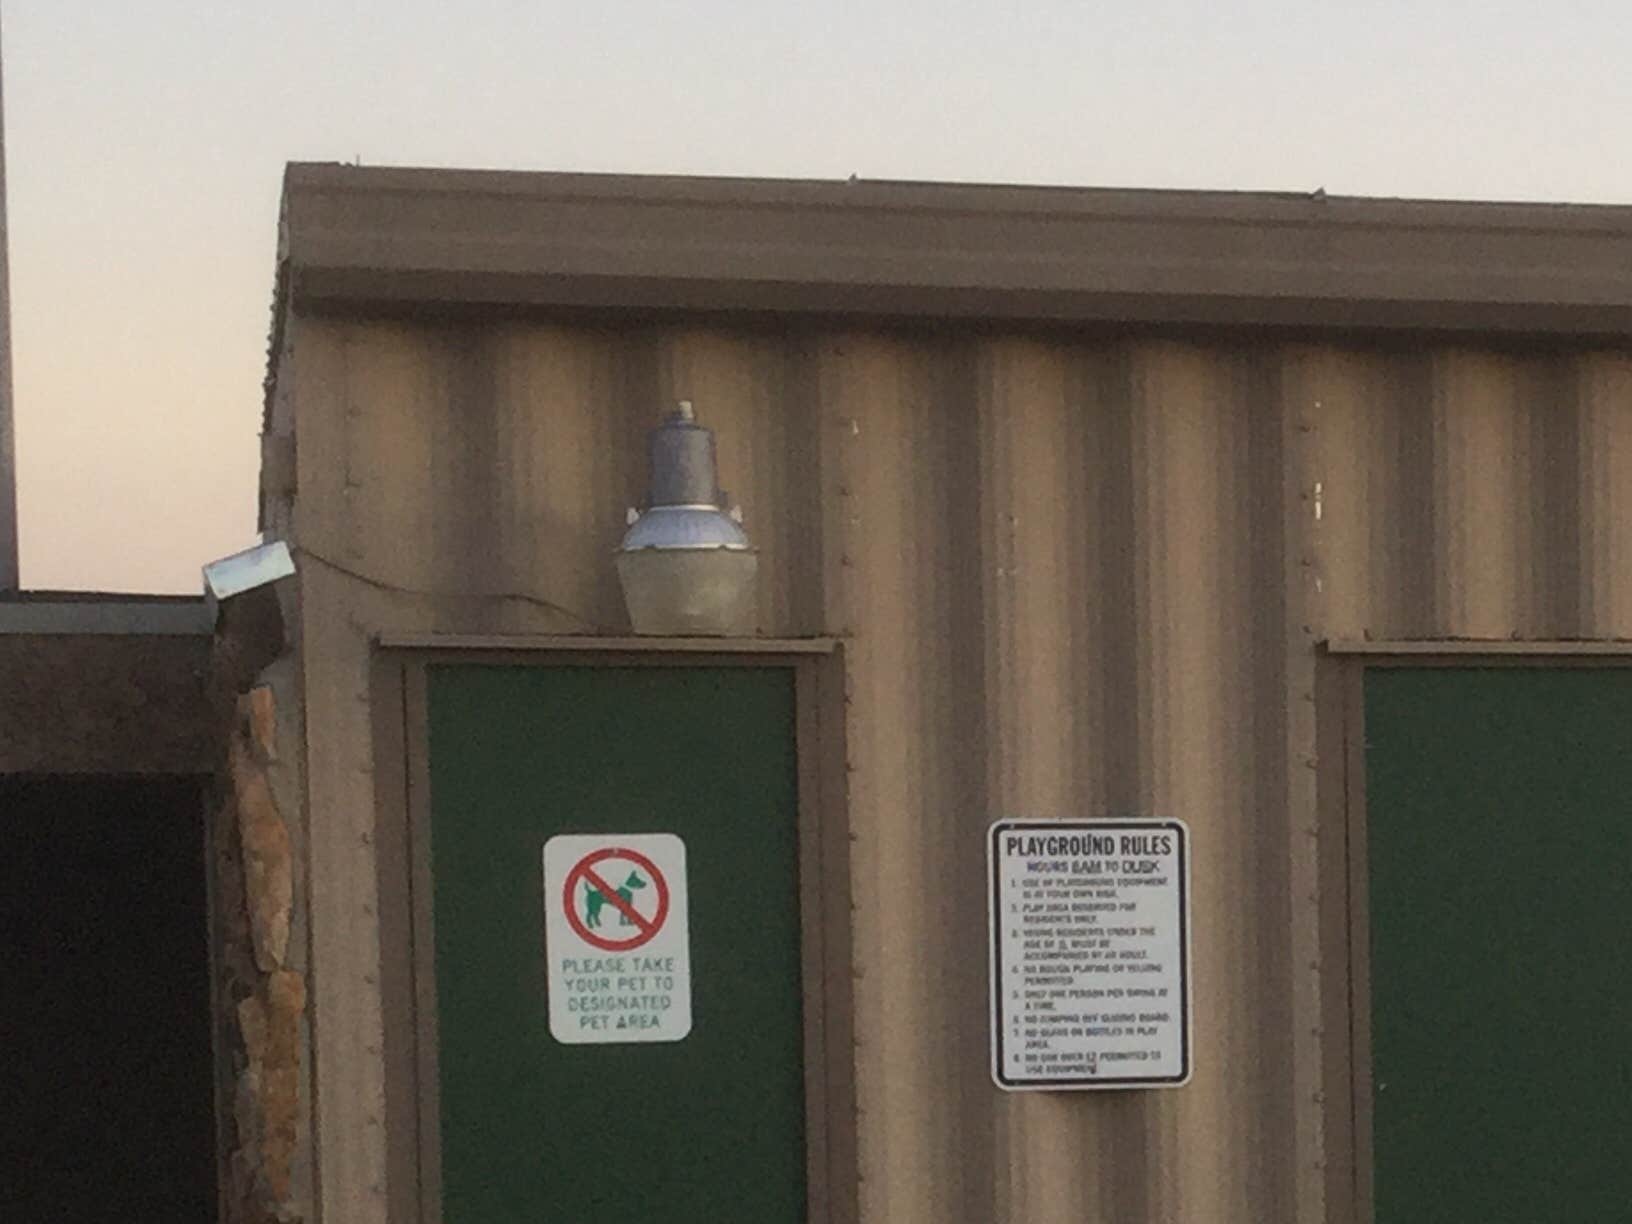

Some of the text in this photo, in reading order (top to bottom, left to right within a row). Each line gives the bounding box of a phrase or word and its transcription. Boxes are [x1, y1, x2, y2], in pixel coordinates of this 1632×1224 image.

[1007, 836, 1171, 856] PLAYGROUND RULES
[1106, 861, 1118, 872] TO
[1122, 860, 1160, 874] DUSK
[562, 957, 674, 973] PLEASE TAKE
[565, 976, 674, 992] YOUR PET TO
[568, 995, 672, 1011] DESIGNATED
[580, 1015, 661, 1029] PET AREA
